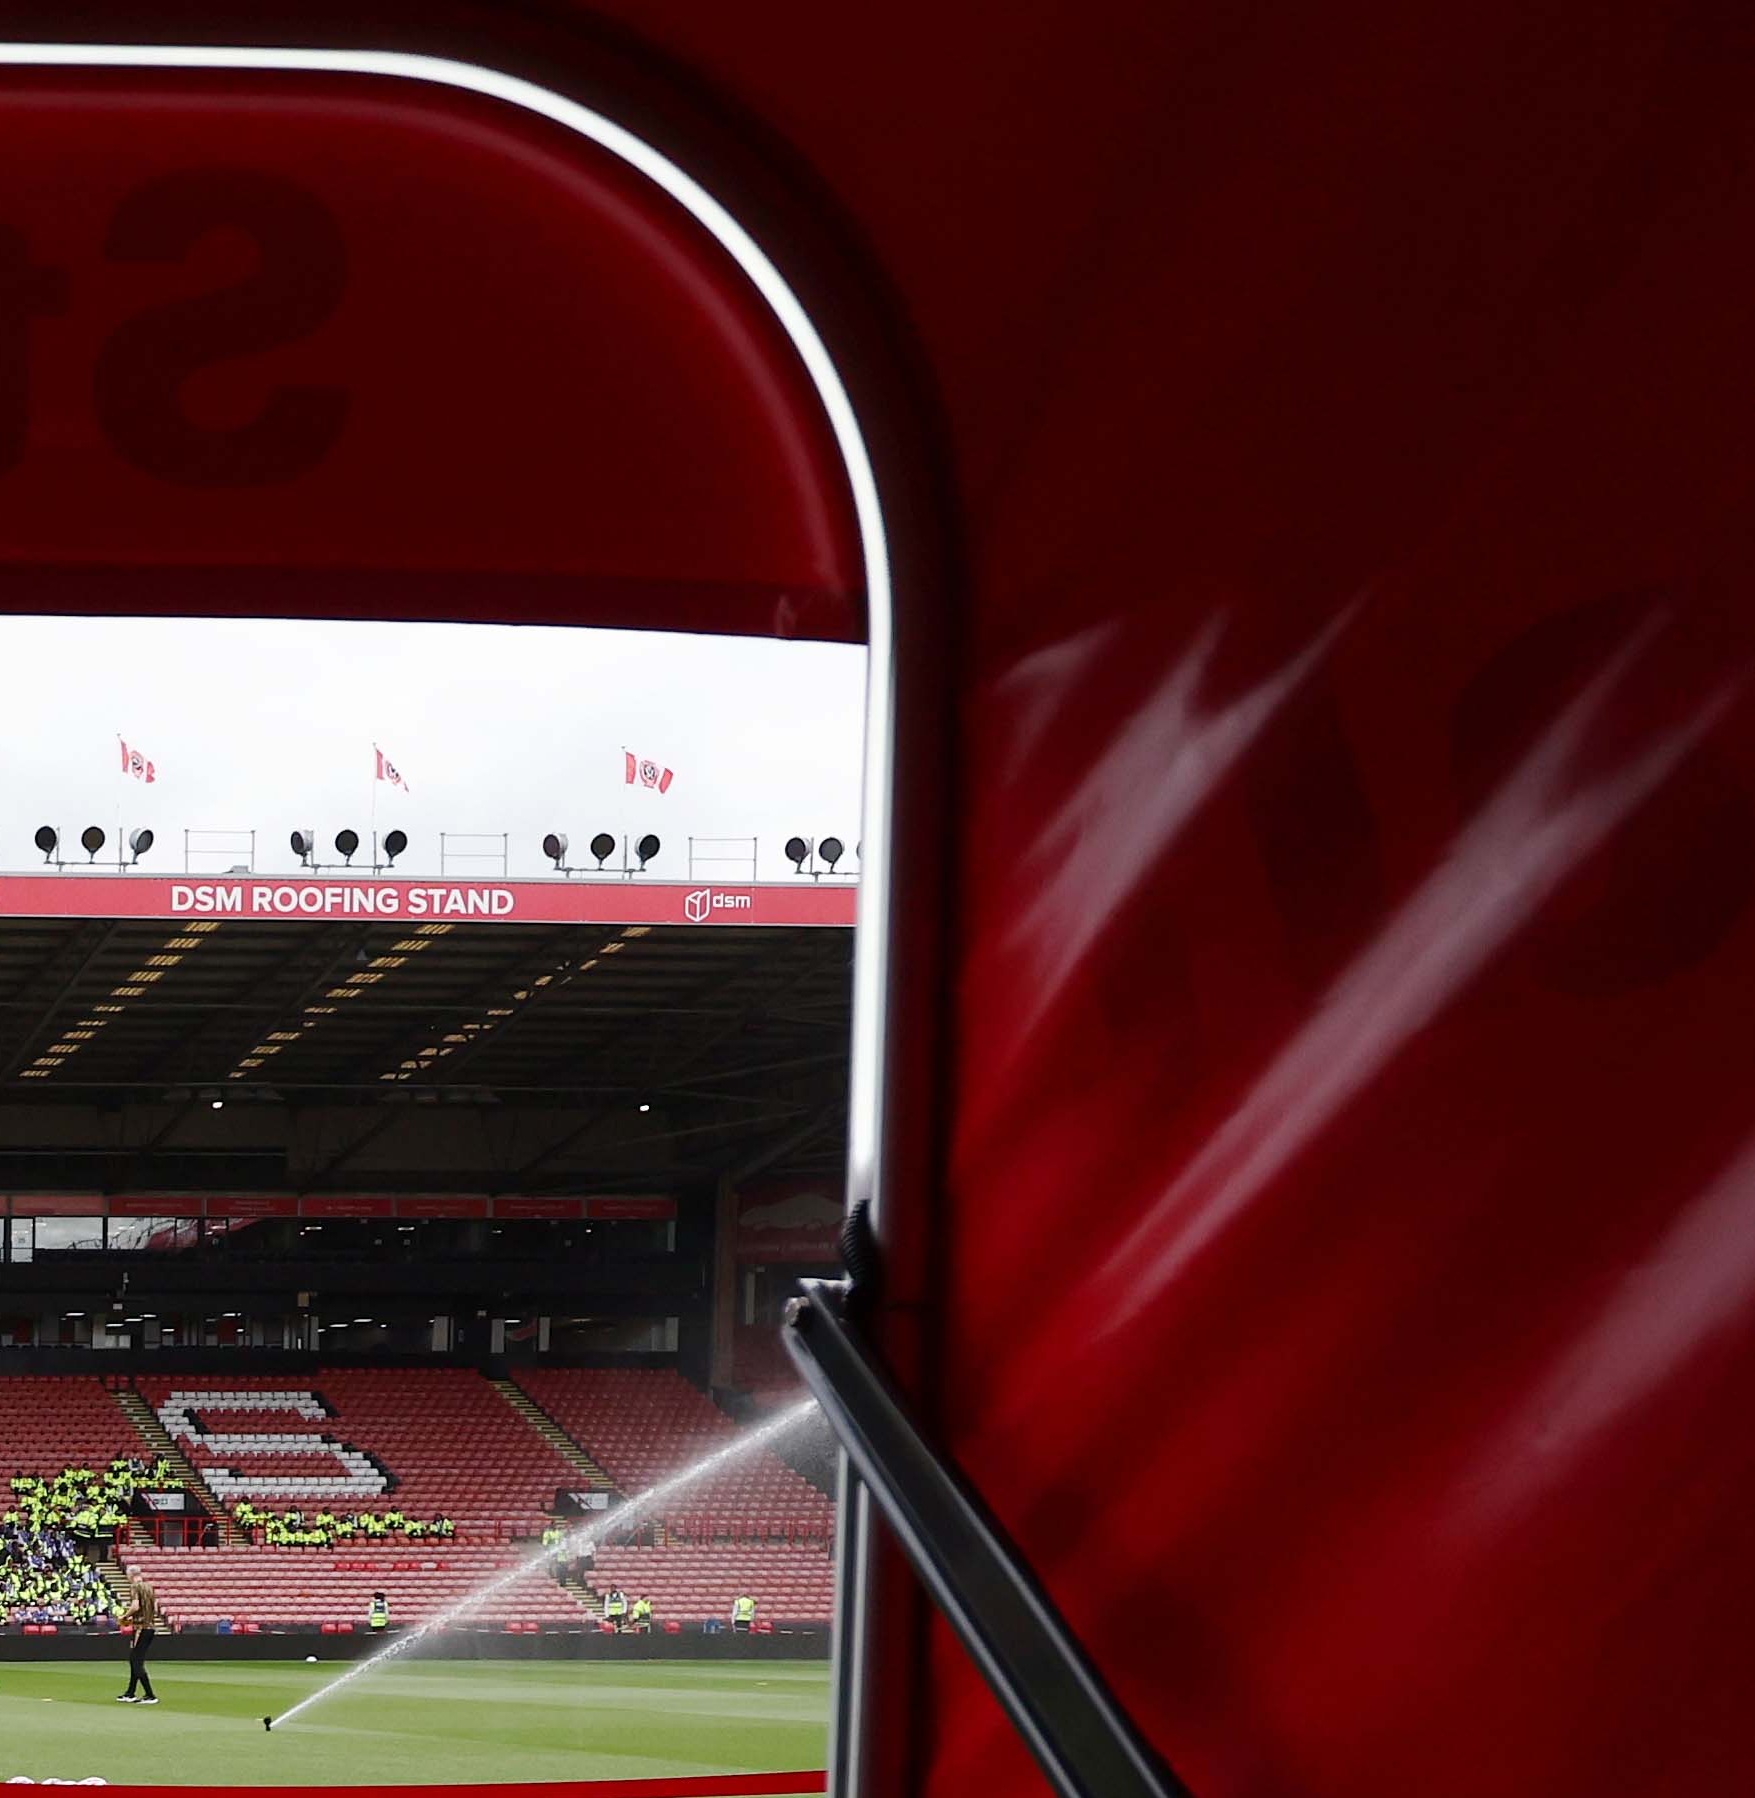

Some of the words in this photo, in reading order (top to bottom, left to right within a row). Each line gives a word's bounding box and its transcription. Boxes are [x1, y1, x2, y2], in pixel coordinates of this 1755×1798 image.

[171, 885, 243, 912] DSM
[252, 886, 399, 914] ROOFING
[407, 888, 514, 915] STAND
[712, 892, 751, 909] dsm
